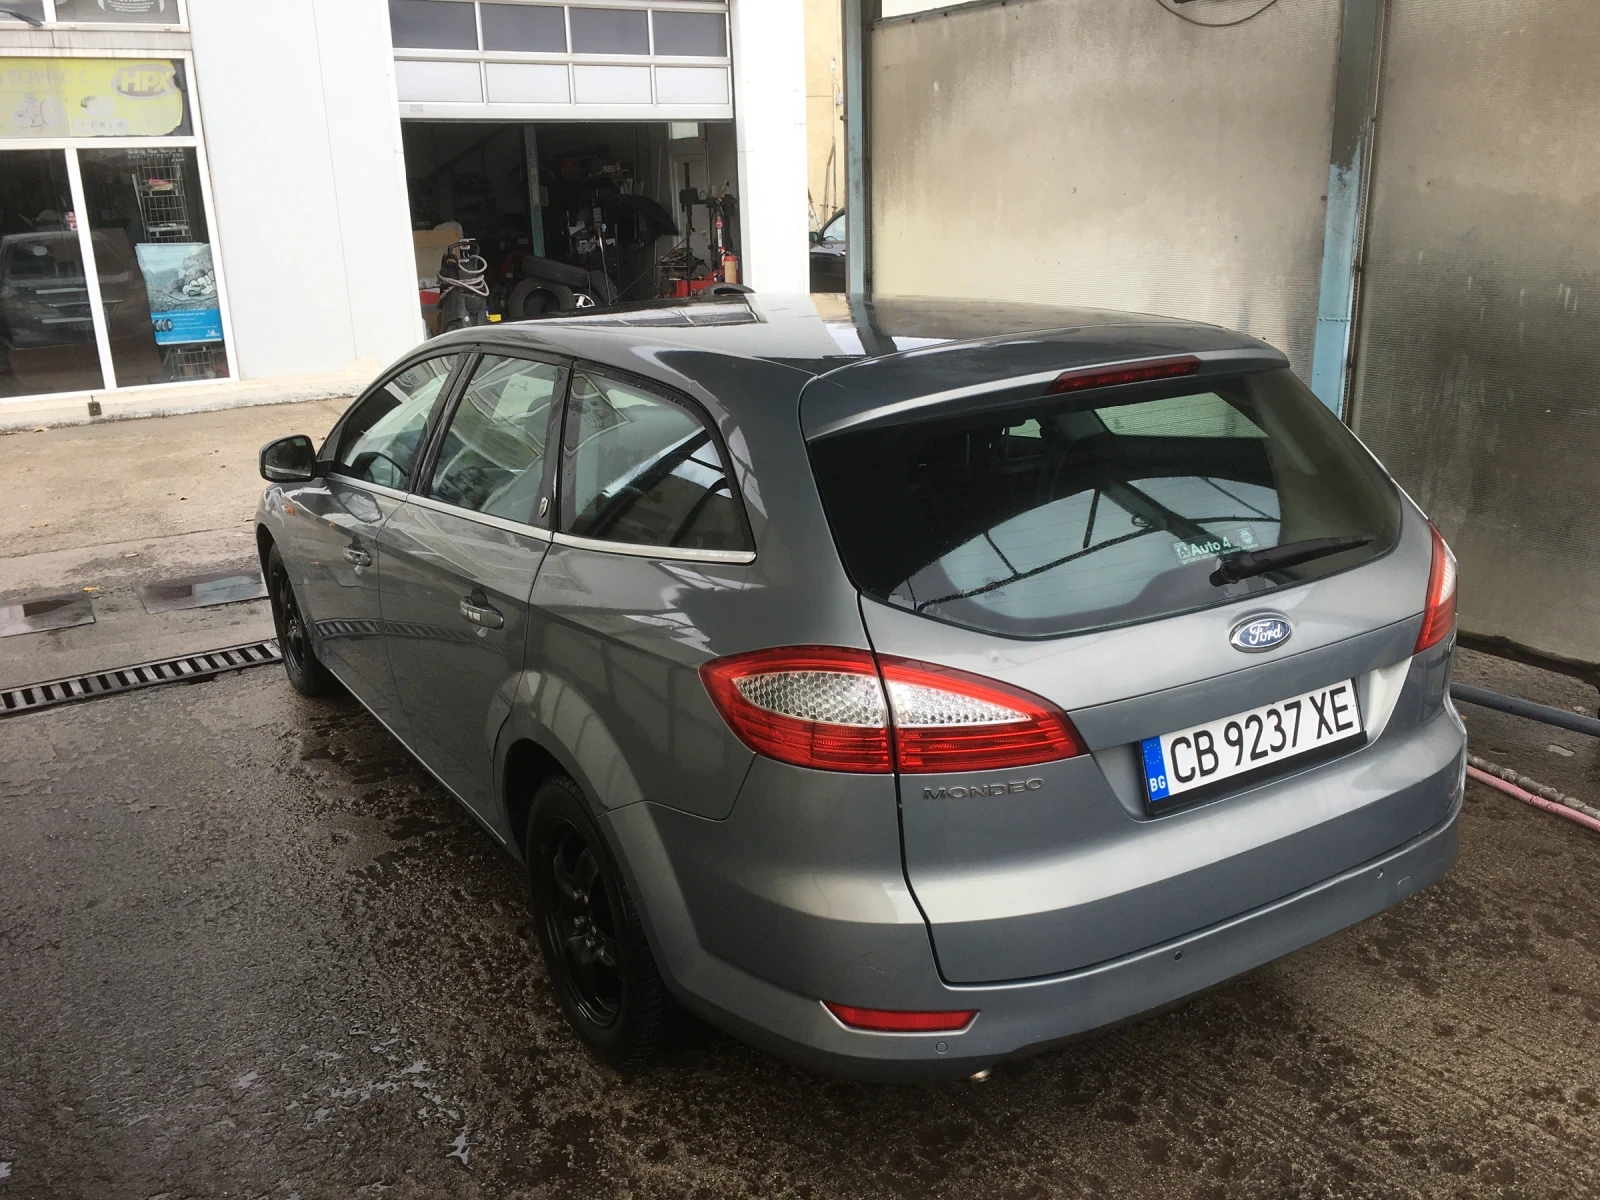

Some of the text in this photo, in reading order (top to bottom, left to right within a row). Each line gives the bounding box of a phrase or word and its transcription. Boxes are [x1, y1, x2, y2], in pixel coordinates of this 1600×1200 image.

[121, 70, 174, 92] HPX
[1190, 541, 1221, 556] Auto
[1222, 536, 1232, 548] 4
[1248, 621, 1283, 645] Ford
[1170, 686, 1354, 783] CB 9237 XE
[923, 777, 1045, 800] MONDEO
[1150, 776, 1166, 793] BG
